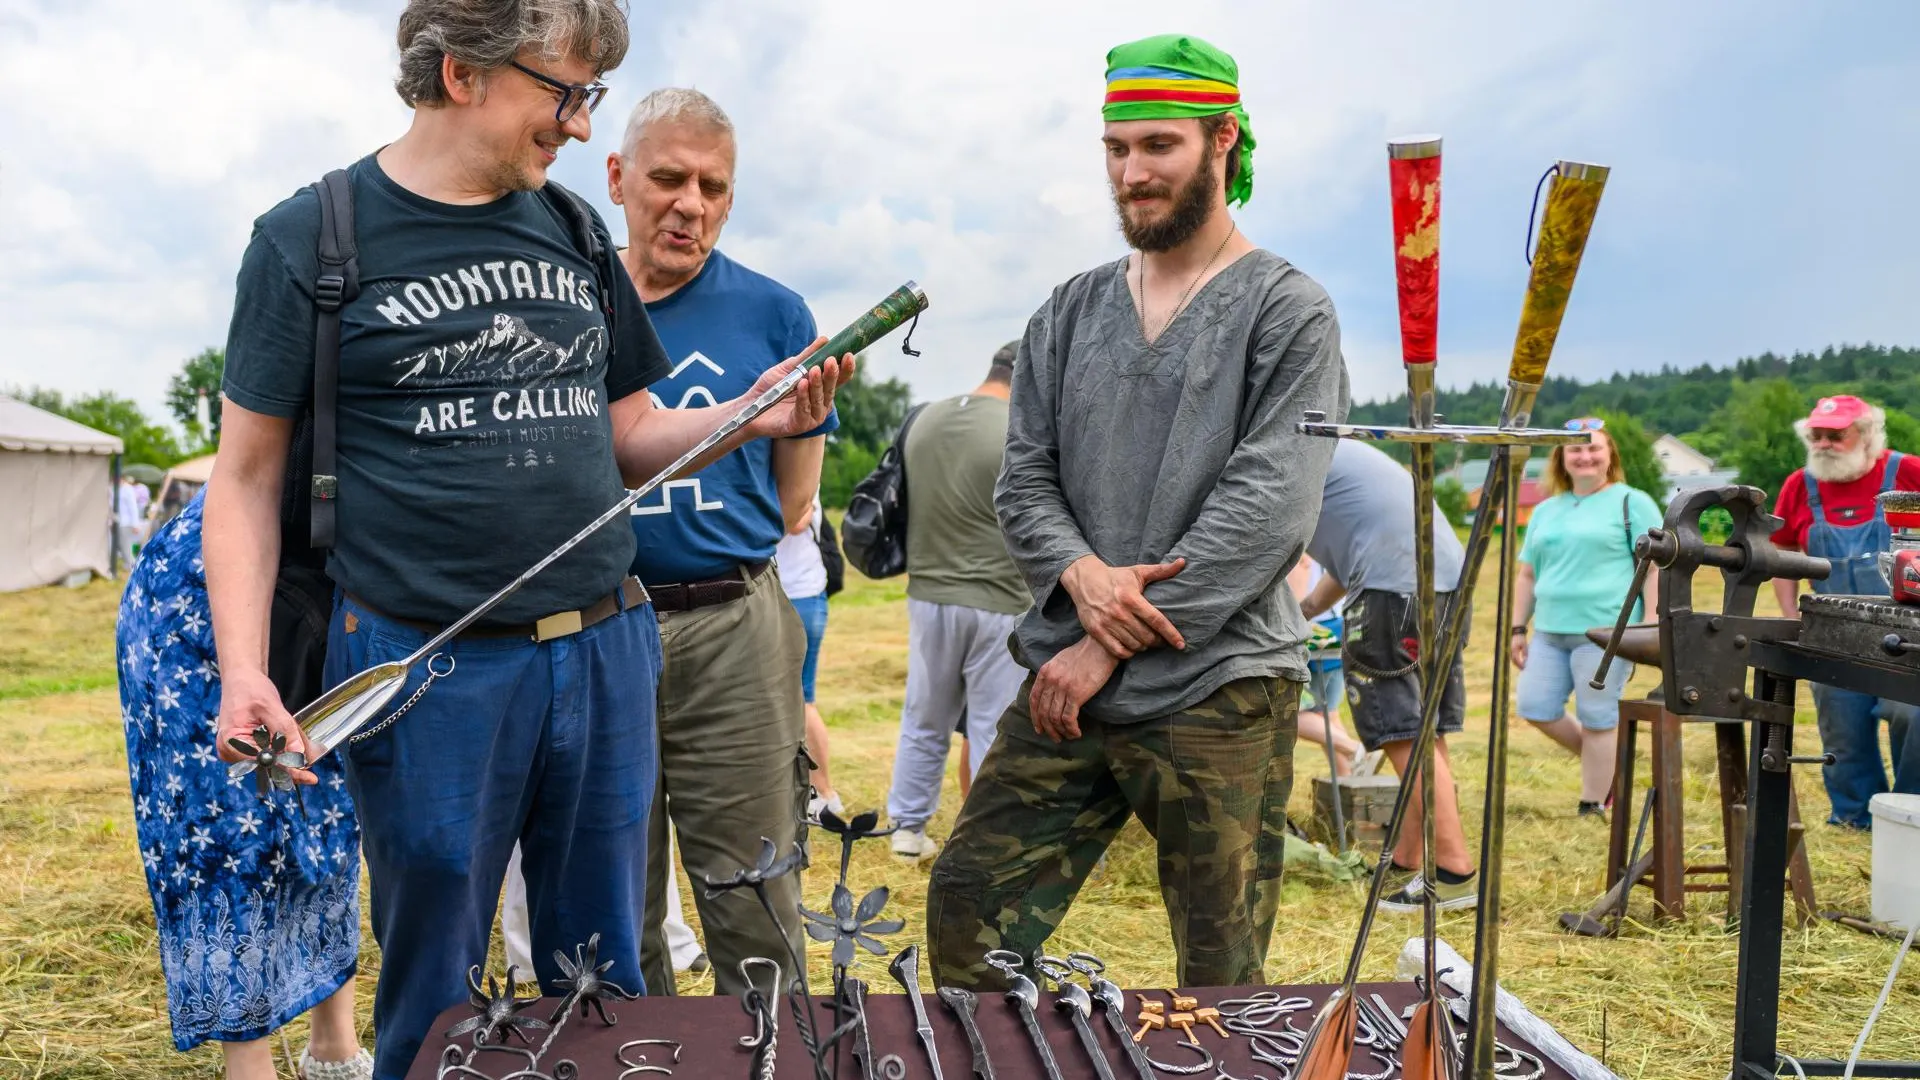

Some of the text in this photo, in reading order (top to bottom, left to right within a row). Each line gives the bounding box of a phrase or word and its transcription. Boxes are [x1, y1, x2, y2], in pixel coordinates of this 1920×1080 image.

[376, 260, 594, 326] MOUNTAINS
[415, 388, 598, 435] ARE CALLING
[506, 429, 513, 444] I
[520, 426, 556, 442] MUST
